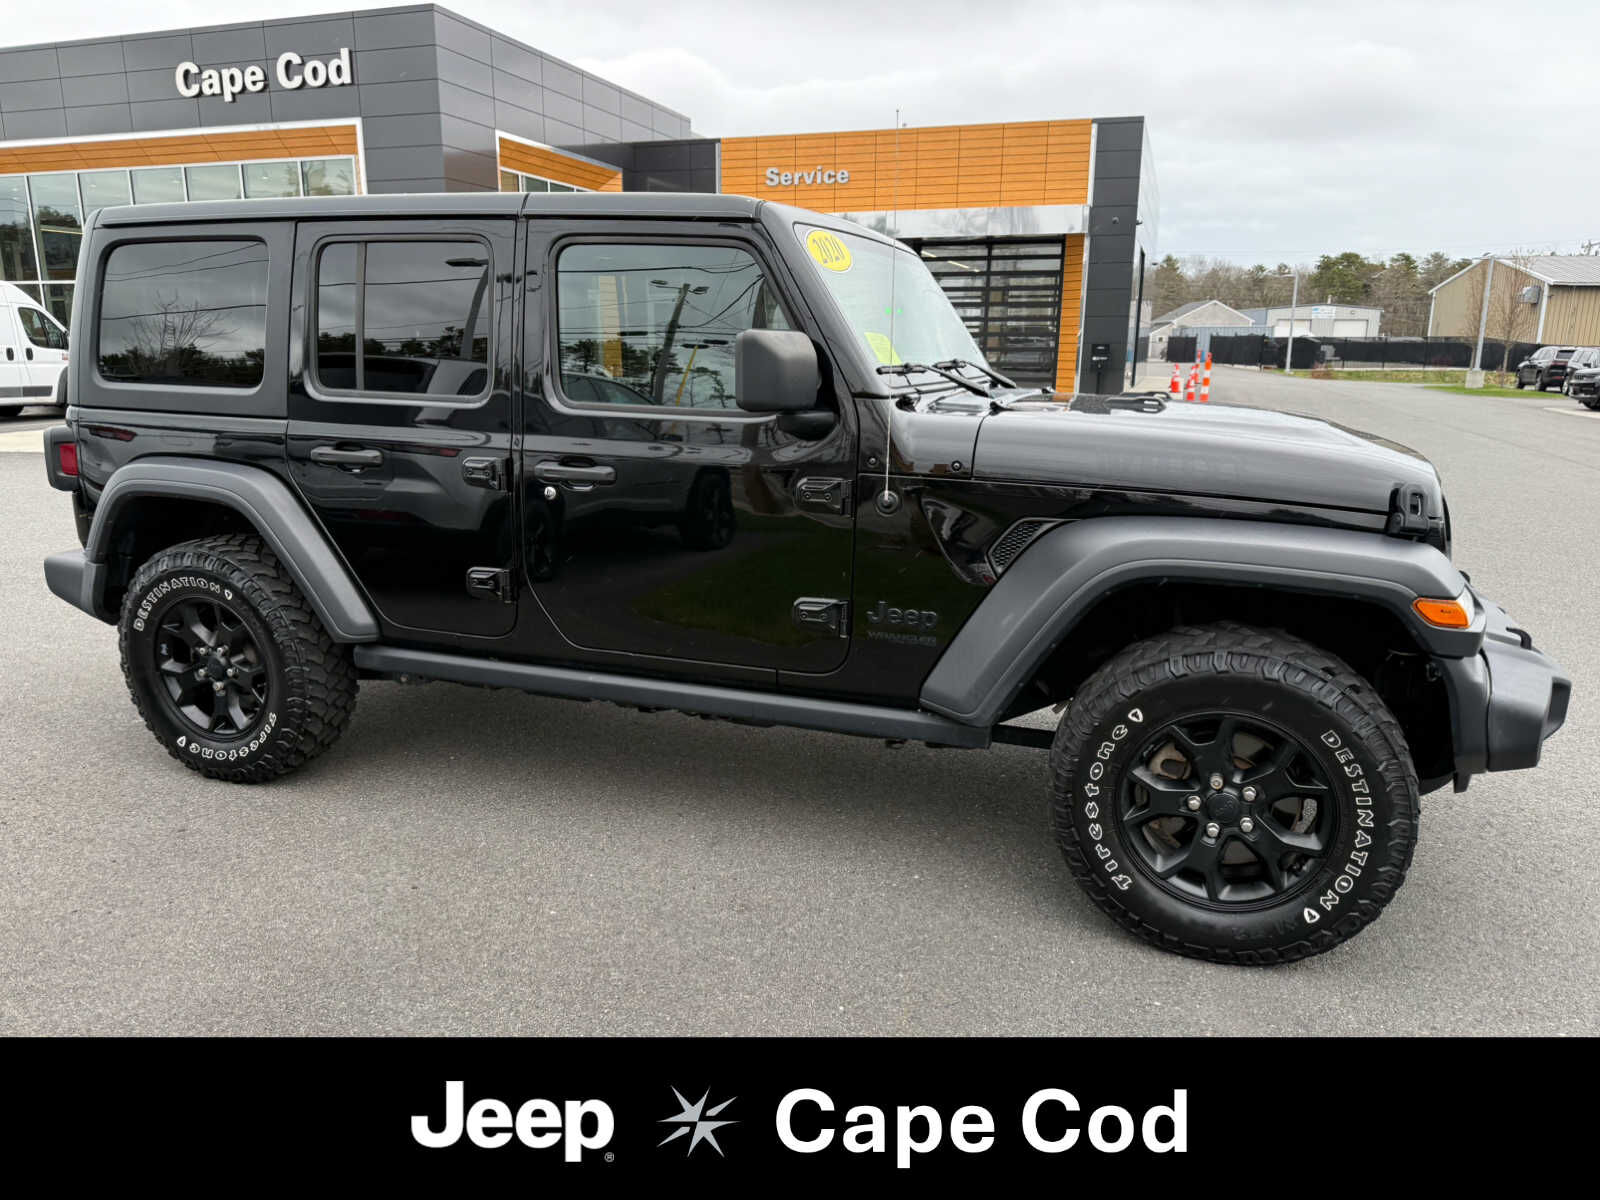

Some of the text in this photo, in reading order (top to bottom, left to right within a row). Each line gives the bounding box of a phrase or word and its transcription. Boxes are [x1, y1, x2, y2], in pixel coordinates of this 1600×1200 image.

[175, 47, 352, 103] Cape Cod
[765, 165, 850, 187] Service
[811, 234, 846, 265] 2020
[133, 576, 221, 632] DESTINATION
[866, 600, 938, 632] Jeep
[1320, 729, 1375, 912] DESTINATION
